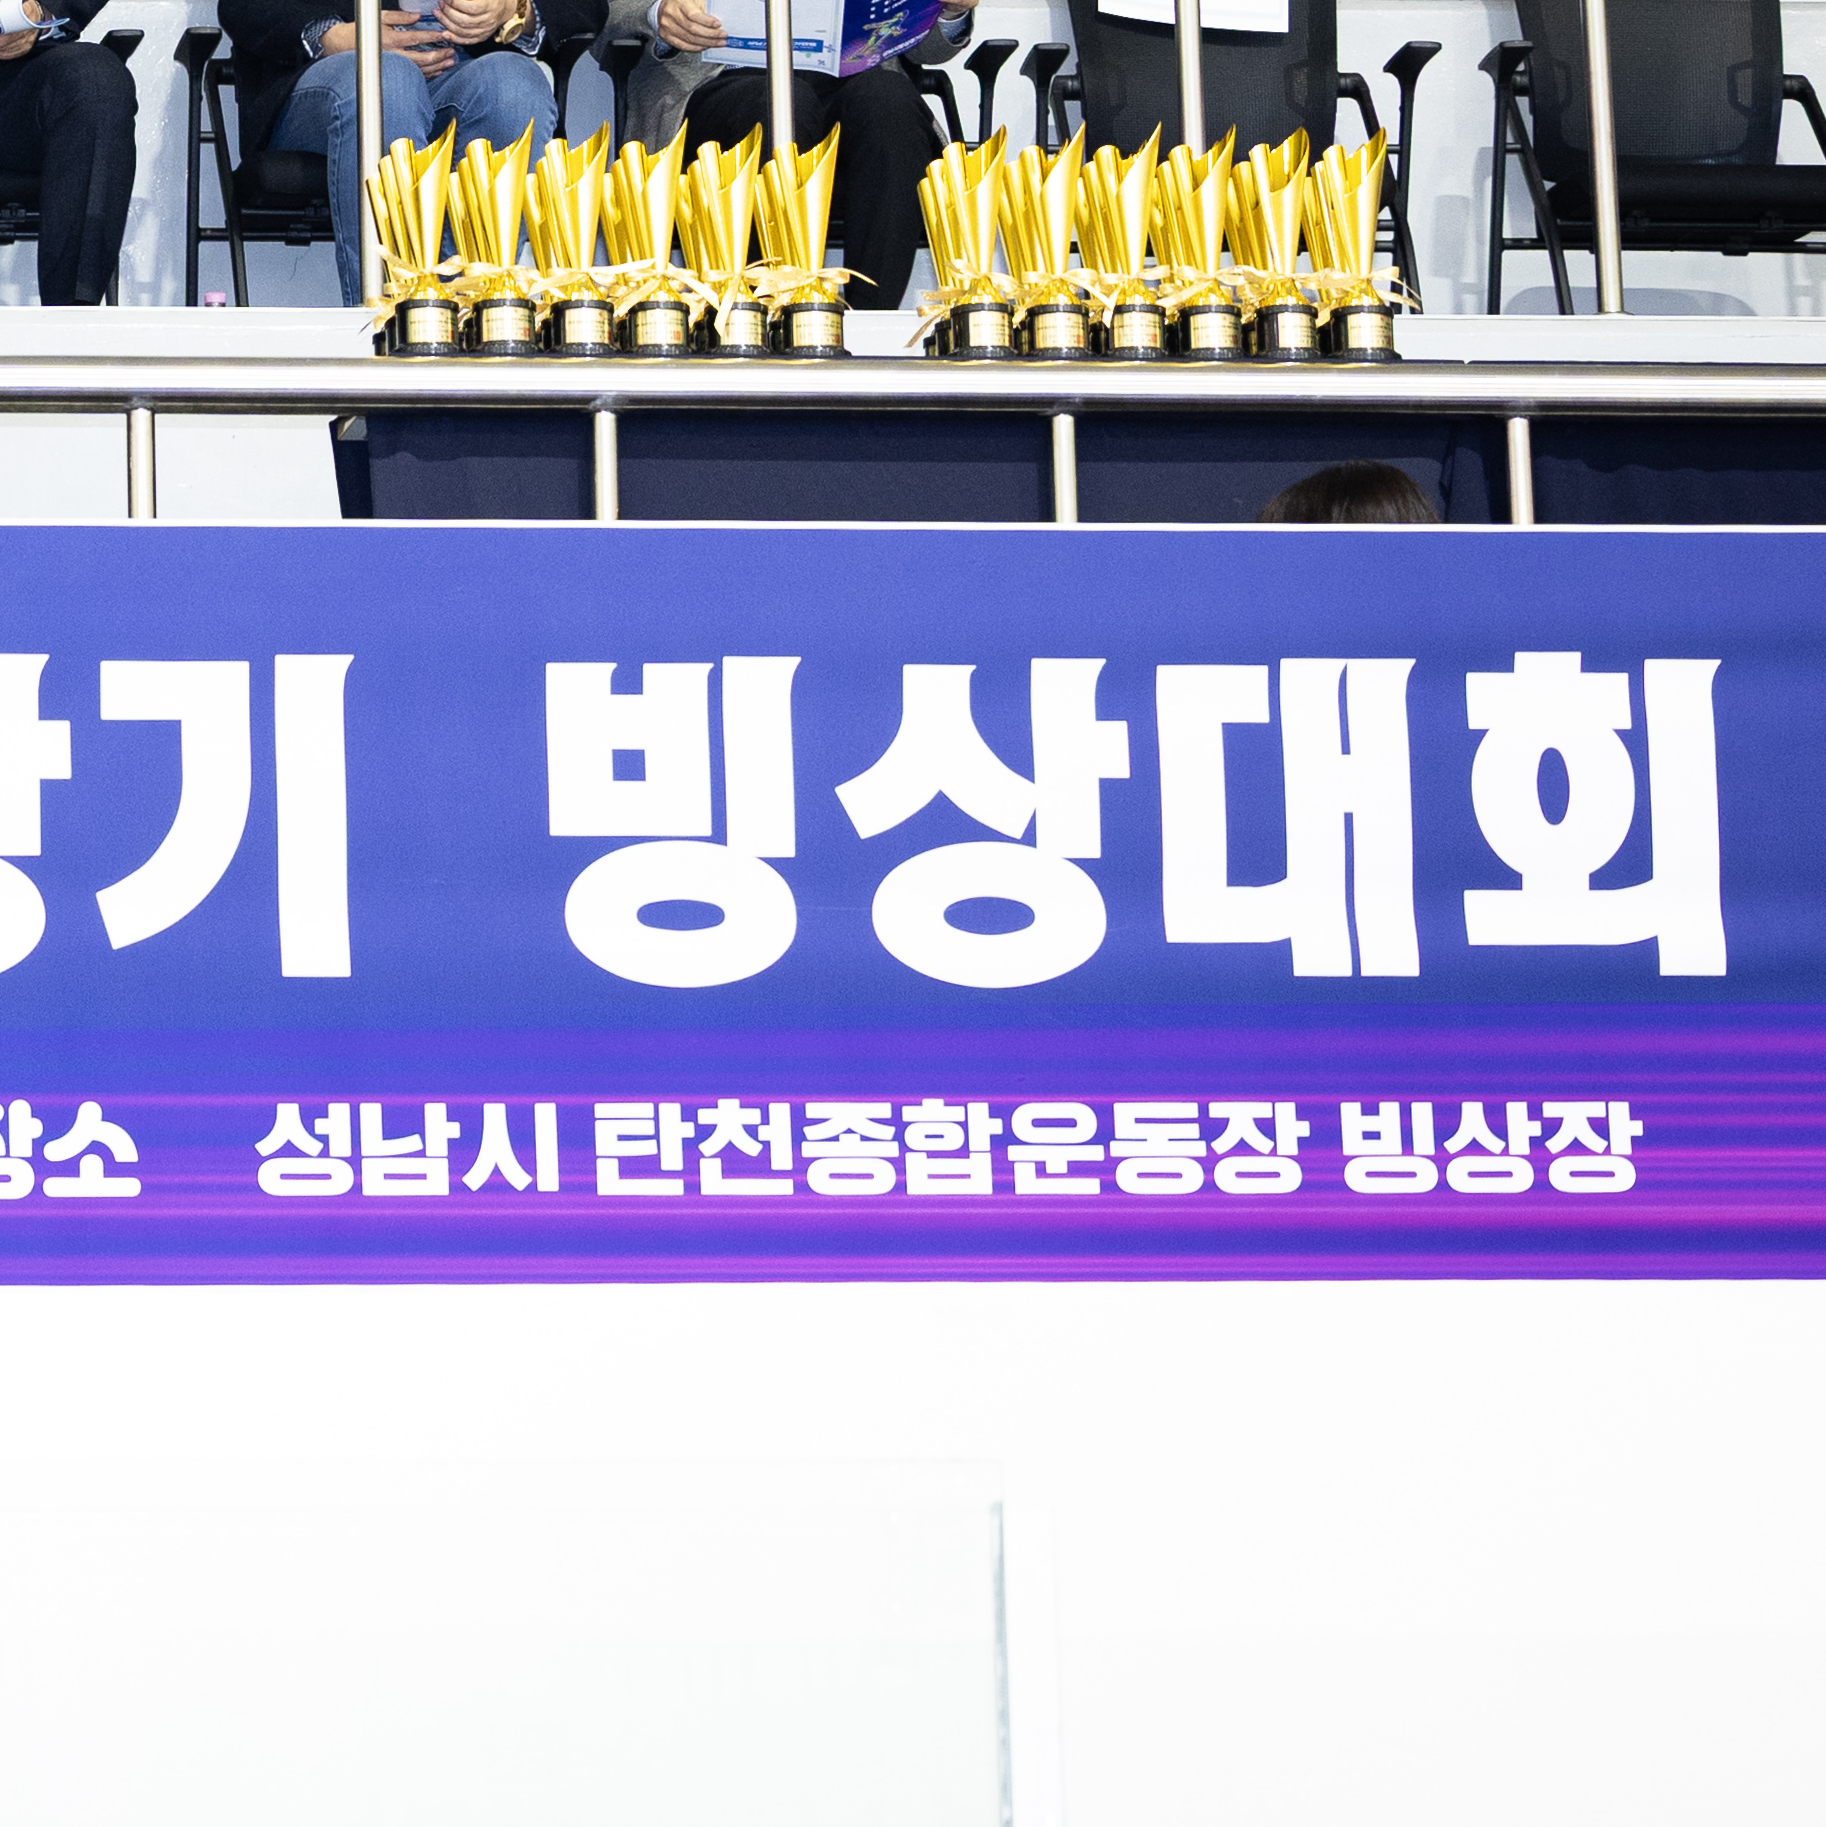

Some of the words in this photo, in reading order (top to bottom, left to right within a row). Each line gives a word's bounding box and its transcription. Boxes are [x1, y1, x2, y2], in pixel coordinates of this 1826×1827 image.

[545, 651, 1727, 989] 빙상대회
[254, 1102, 560, 1197] 성남시
[594, 1098, 1310, 1196] 탄천종합운동장
[1340, 1101, 1644, 1194] 빙상장
